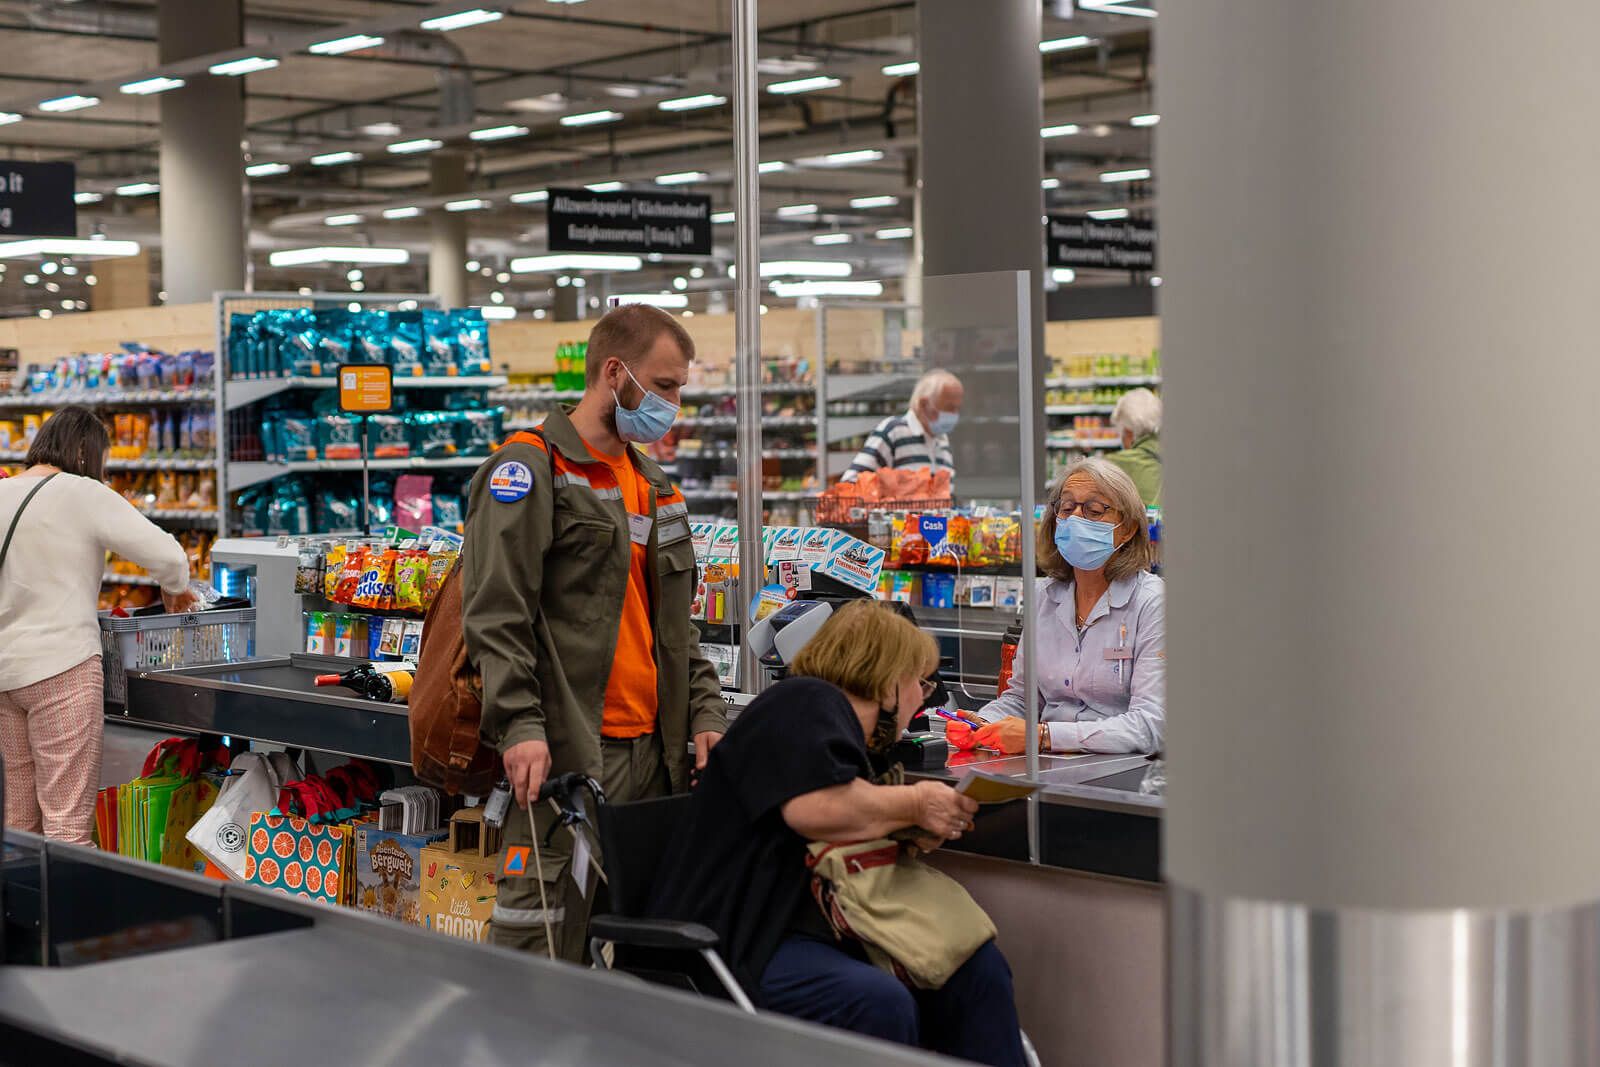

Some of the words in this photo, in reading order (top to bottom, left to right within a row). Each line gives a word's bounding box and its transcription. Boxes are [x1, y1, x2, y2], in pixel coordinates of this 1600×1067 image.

[923, 520, 944, 530] Cash
[356, 582, 383, 597] OCKS
[371, 854, 412, 877] Bergwelt
